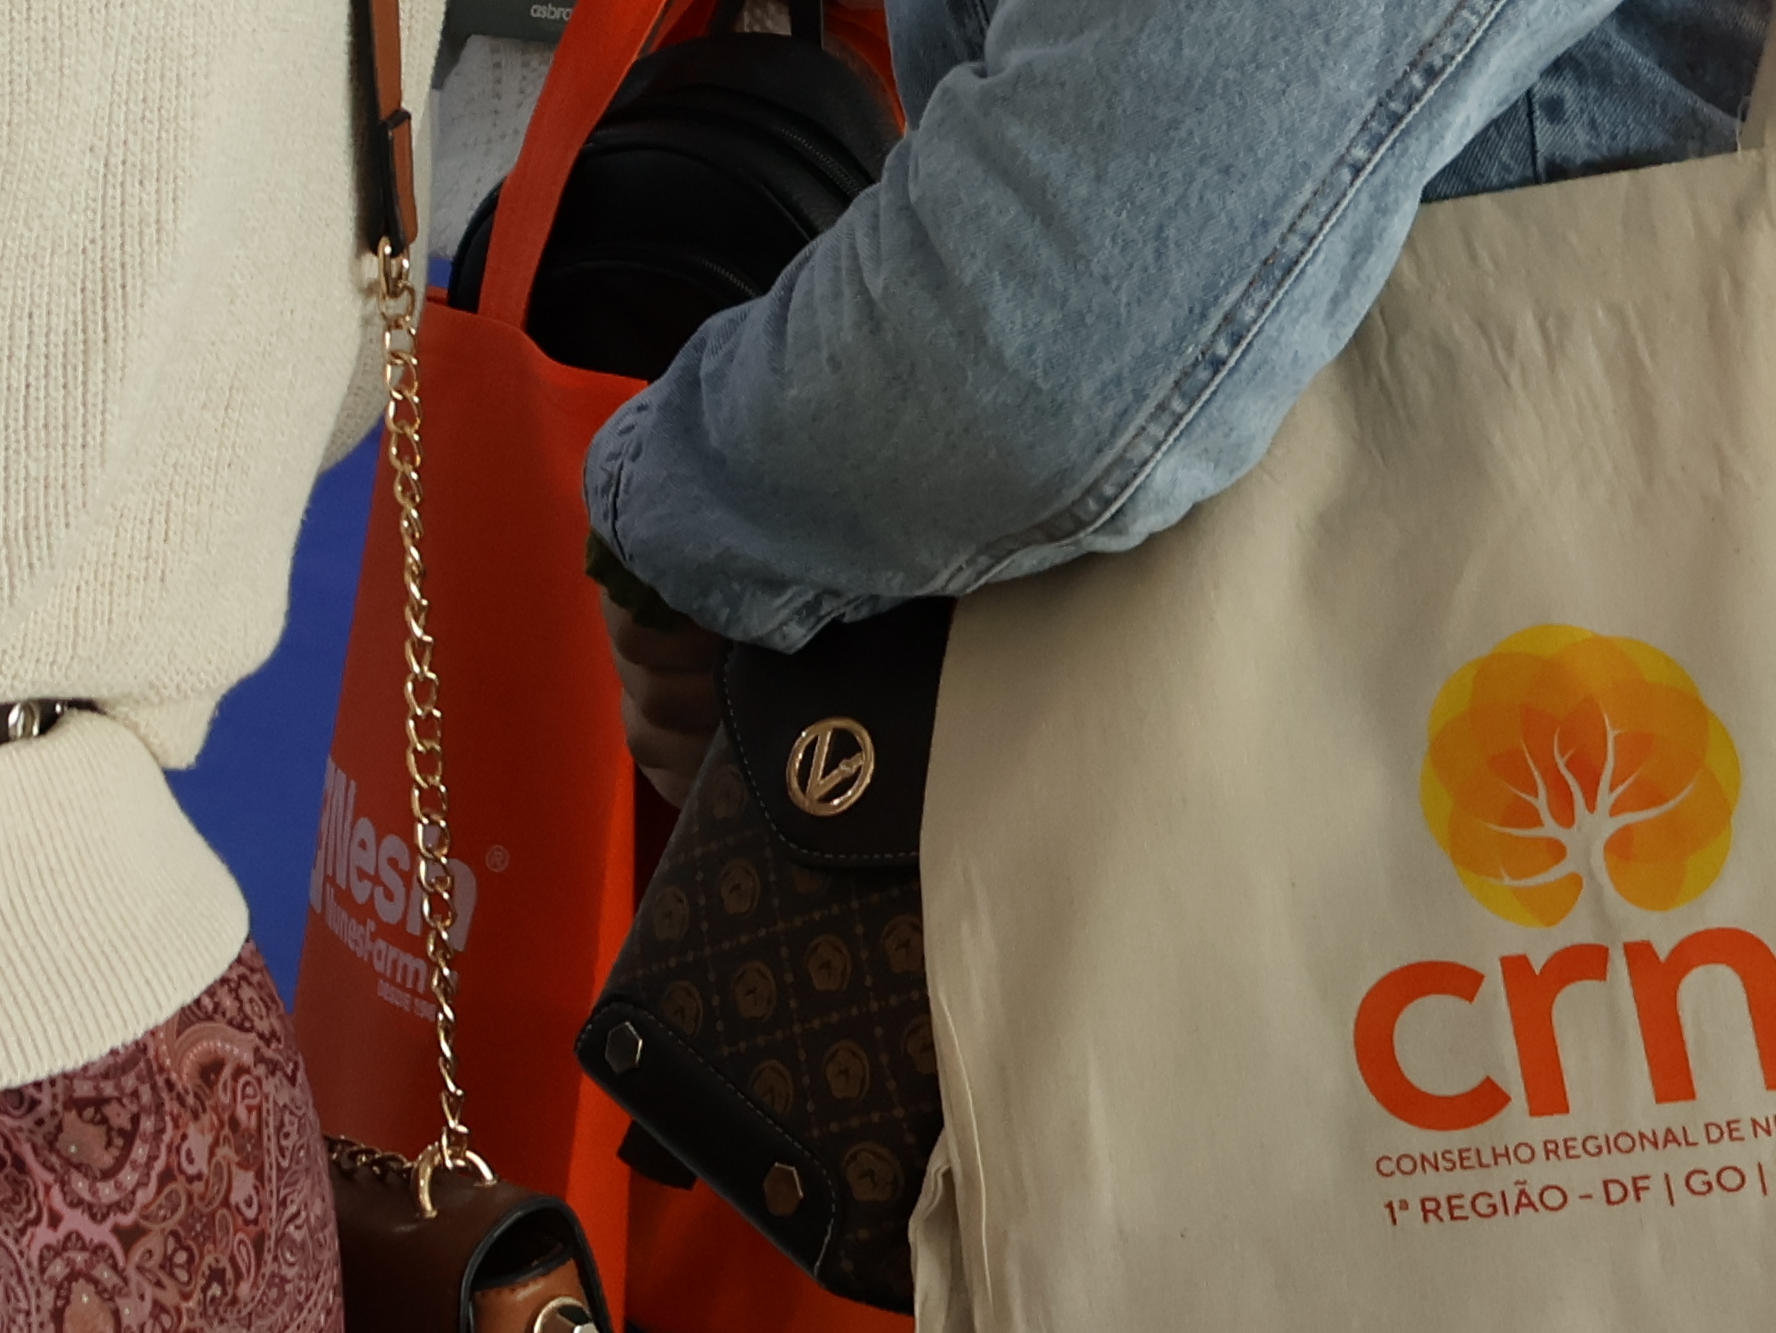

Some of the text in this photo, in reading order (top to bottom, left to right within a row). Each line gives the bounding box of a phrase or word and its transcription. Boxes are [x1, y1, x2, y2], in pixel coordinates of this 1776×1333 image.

[1353, 927, 1776, 1131] crn
[1375, 1114, 1776, 1178] CONSELHO REGIONAL DE N
[1420, 1179, 1568, 1224] REGIÃO
[1602, 1174, 1653, 1207] DF
[1685, 1165, 1746, 1196] GO
